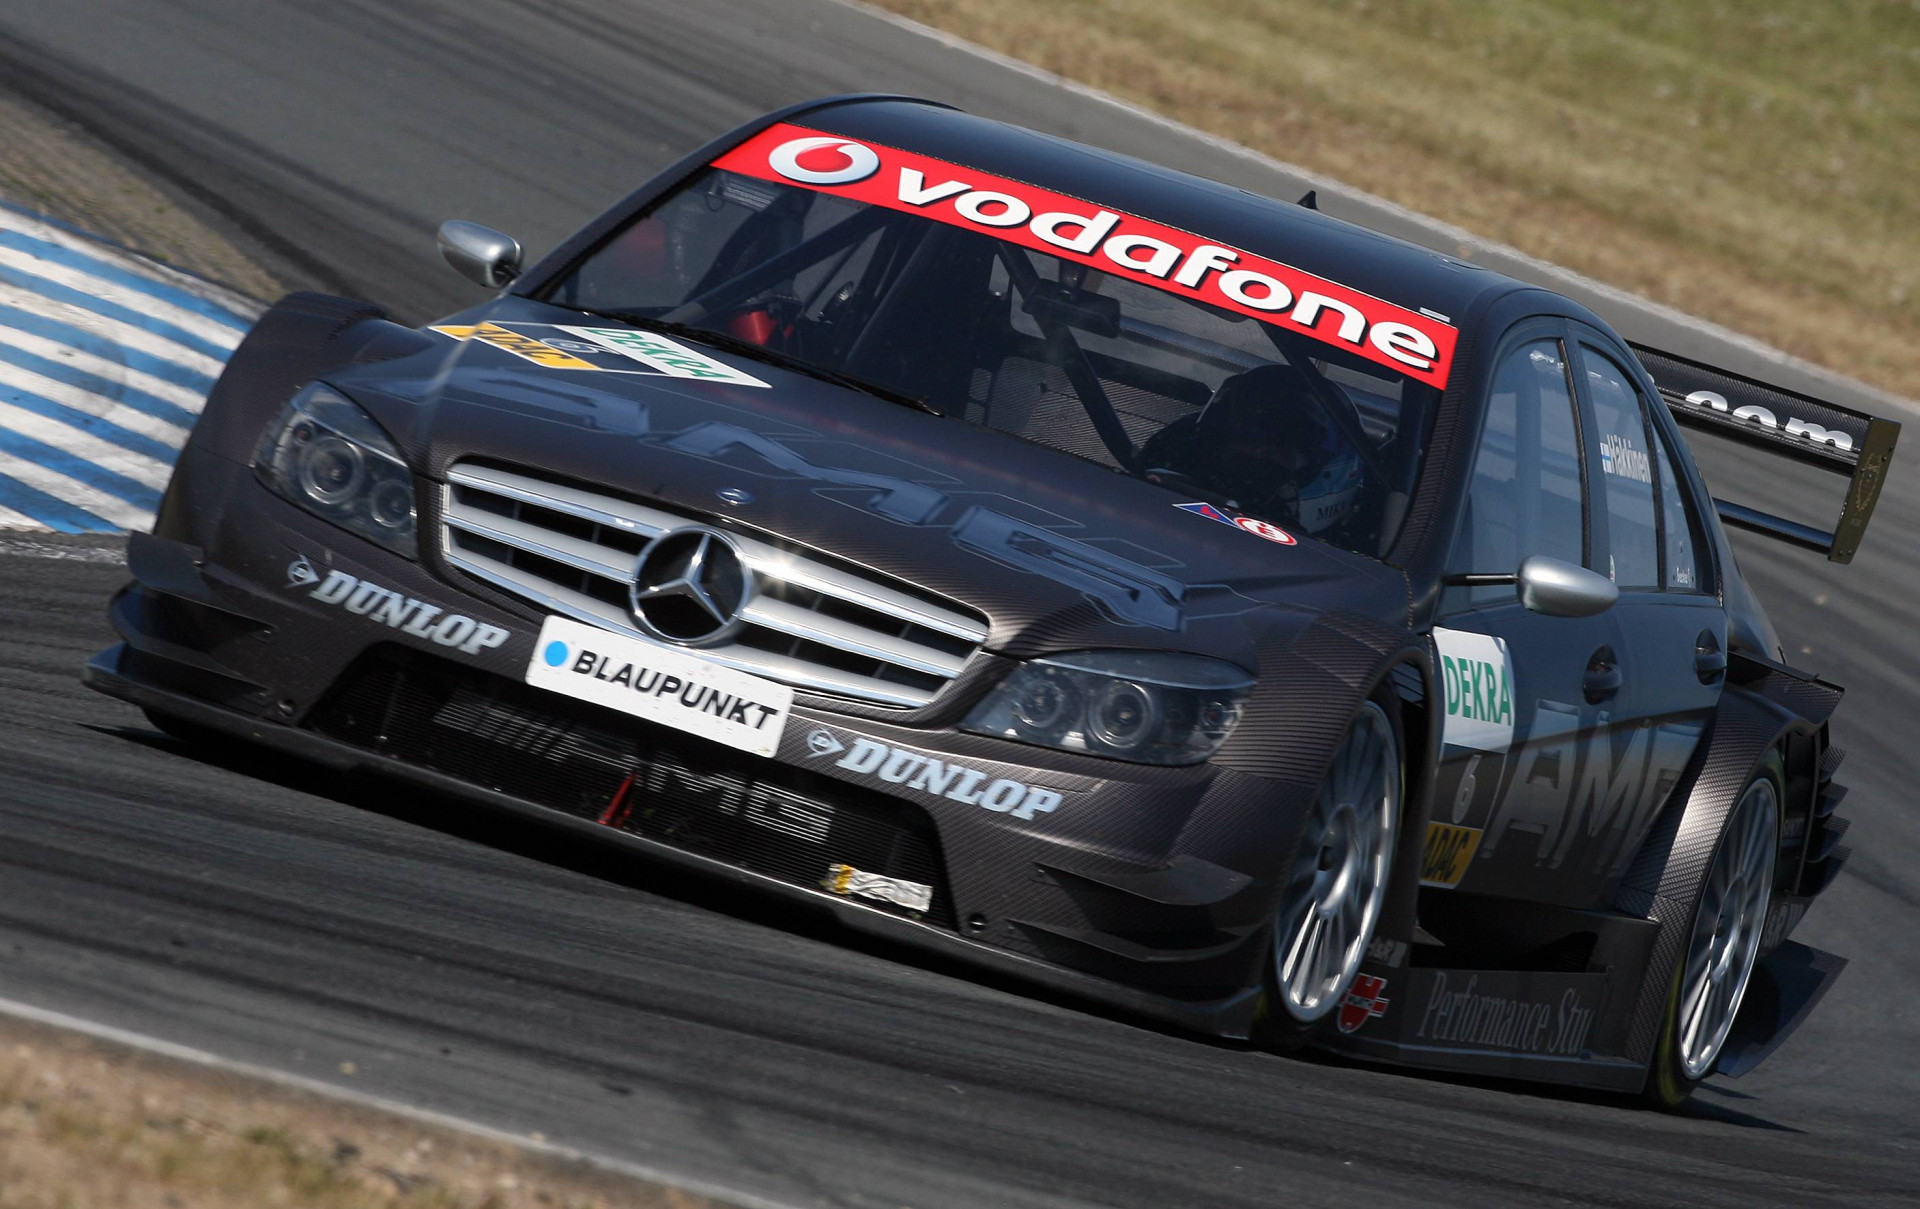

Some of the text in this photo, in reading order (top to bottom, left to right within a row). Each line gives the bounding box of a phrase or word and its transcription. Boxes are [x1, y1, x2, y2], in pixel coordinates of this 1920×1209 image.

[898, 166, 1438, 368] vodafone
[478, 328, 567, 359] ADAC
[587, 328, 736, 379] DEKRA
[310, 570, 511, 655] DUNLOP
[571, 649, 779, 731] BLAUPUNKT
[1443, 656, 1512, 726] DEKRA
[836, 737, 1063, 820] DUNLOP
[1453, 755, 1482, 824] 6
[1416, 970, 1551, 1051] Performance
